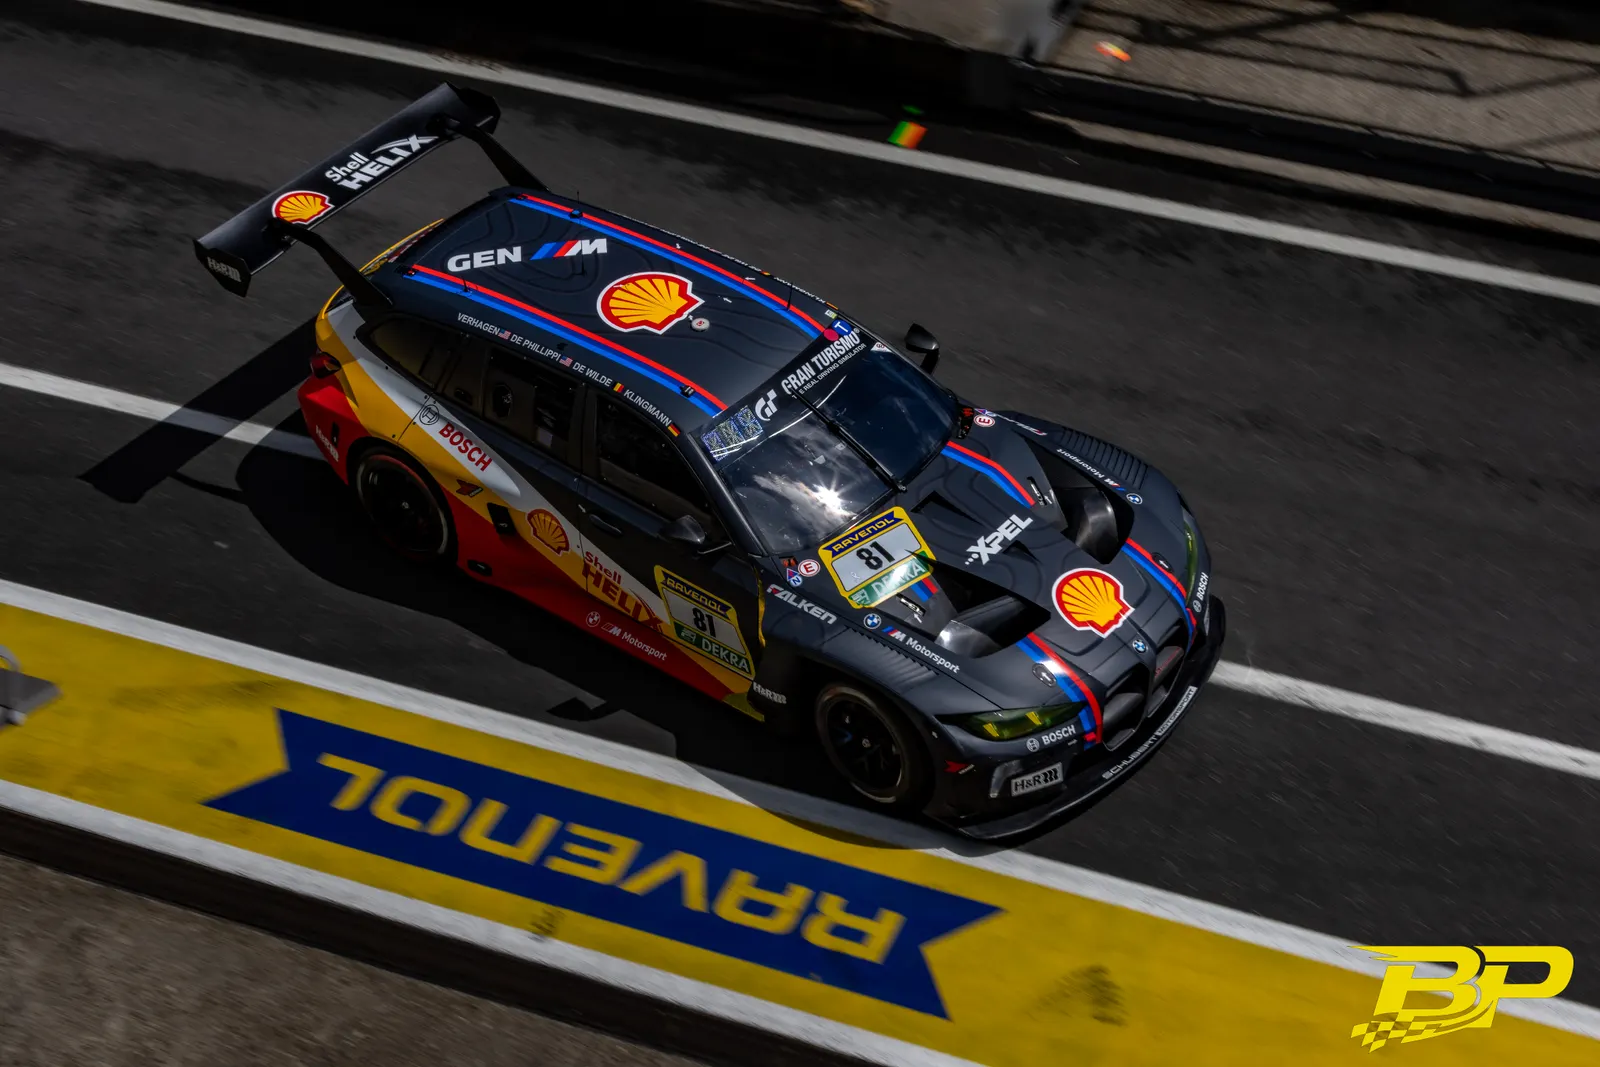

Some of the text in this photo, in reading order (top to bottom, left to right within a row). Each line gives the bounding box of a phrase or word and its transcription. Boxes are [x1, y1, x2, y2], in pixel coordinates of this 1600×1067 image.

[325, 152, 370, 182] Shell
[340, 134, 439, 190] HELIX
[447, 246, 522, 272] GEN
[834, 321, 848, 333] T
[457, 312, 672, 427] VERHAGEN DE PHILLIPPI DE WILDE KLINGMANN
[781, 361, 816, 395] GRAN
[803, 378, 818, 391] REAL
[817, 362, 840, 381] DRIVING
[838, 343, 867, 366] SIMULATOR
[438, 422, 493, 472] BOSCH
[1057, 448, 1103, 479] Motorsport
[832, 516, 895, 552] RAVENOL
[966, 514, 1034, 565] XPEL
[585, 551, 622, 584] Shell
[856, 541, 896, 571] 81
[582, 561, 664, 633] HELIX
[666, 577, 726, 614] RAVENOL
[1196, 573, 1209, 601] BOSCH
[766, 584, 837, 625] FALKEN
[692, 607, 717, 638] 81
[621, 631, 668, 661] Motorsport
[701, 639, 750, 672] DEKRA
[906, 637, 960, 674] Motorsport
[1041, 725, 1077, 746] BOSCH
[1014, 771, 1049, 792] H&R
[316, 752, 907, 965] RAVENOL
